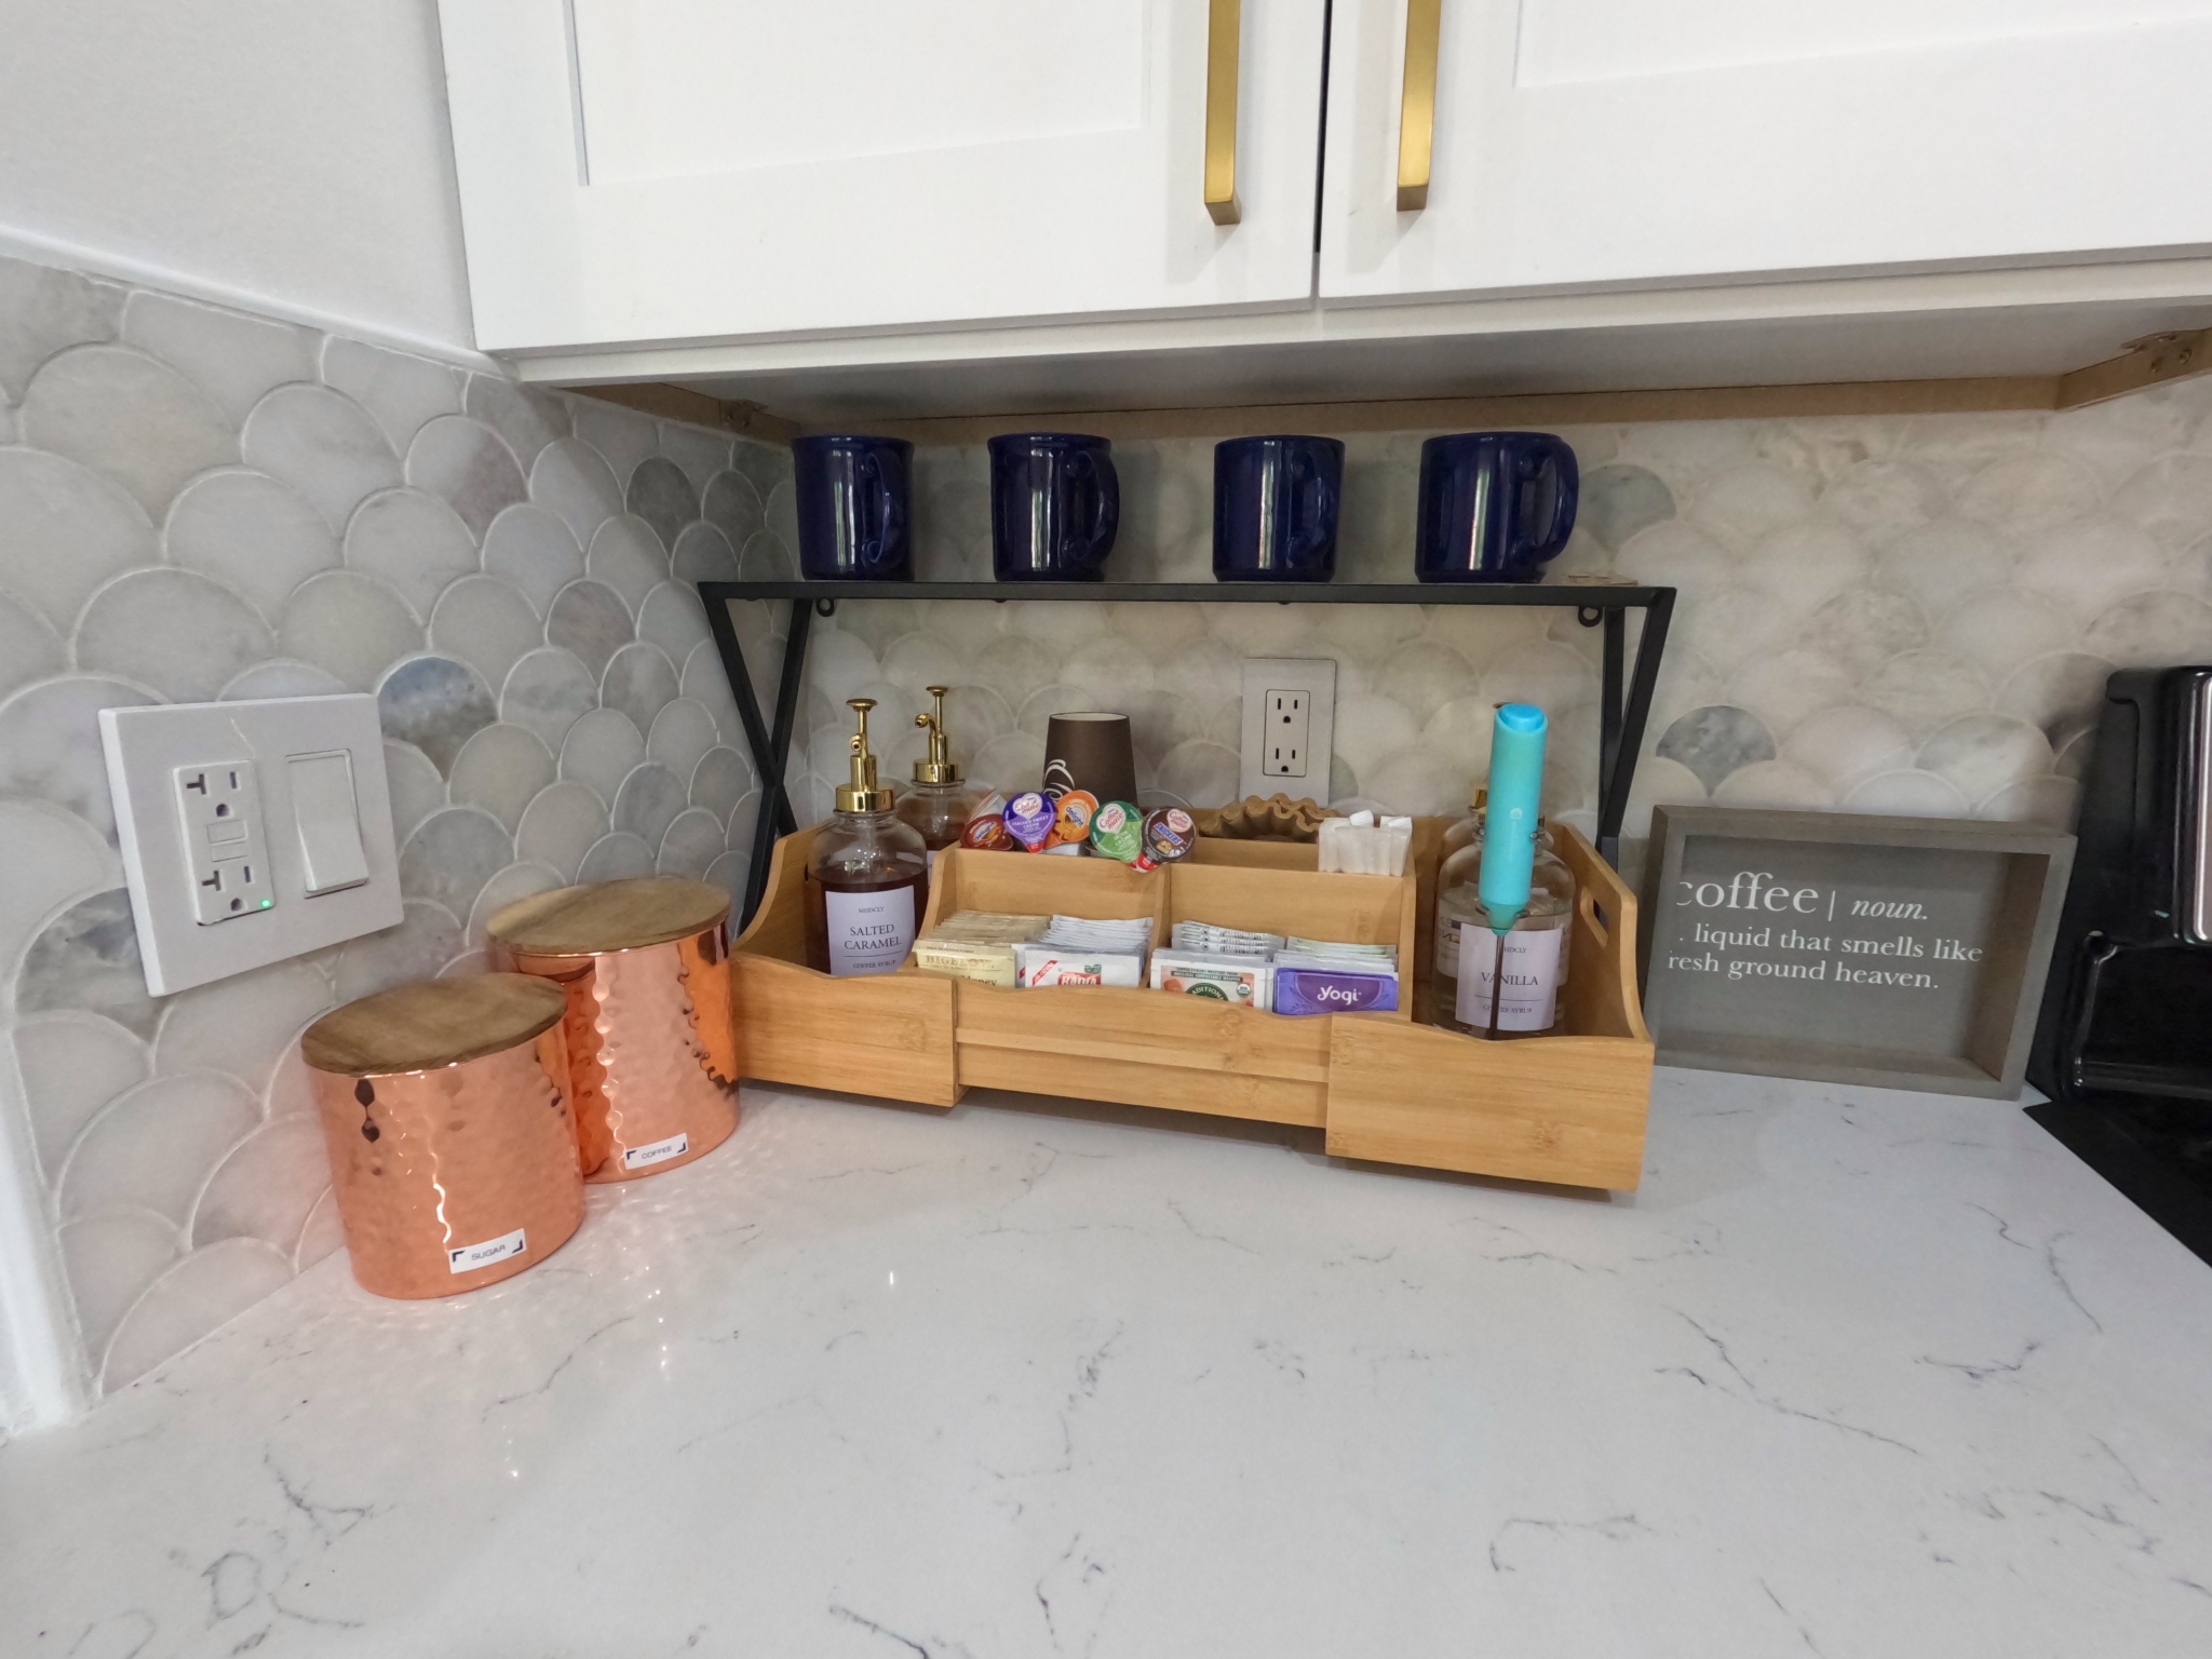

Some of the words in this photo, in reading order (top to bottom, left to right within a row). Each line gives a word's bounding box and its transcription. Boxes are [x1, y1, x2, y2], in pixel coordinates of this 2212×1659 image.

[1099, 810, 1120, 828] Coffee
[1108, 813, 1123, 830] mate
[1850, 899, 1928, 920] noun.
[849, 924, 895, 936] SALTED
[844, 936, 901, 950] CARAMEL
[1694, 922, 1771, 951] liquid
[1780, 929, 1832, 951] that
[1841, 936, 1924, 958] smells
[1932, 938, 1983, 962] like
[1669, 951, 1719, 972] resh
[1727, 959, 1827, 980] ground
[1834, 961, 1939, 989] heaven.
[1317, 985, 1359, 1006] Yogi
[641, 1145, 672, 1160] COFFEE
[471, 1244, 507, 1261] SUGAR
